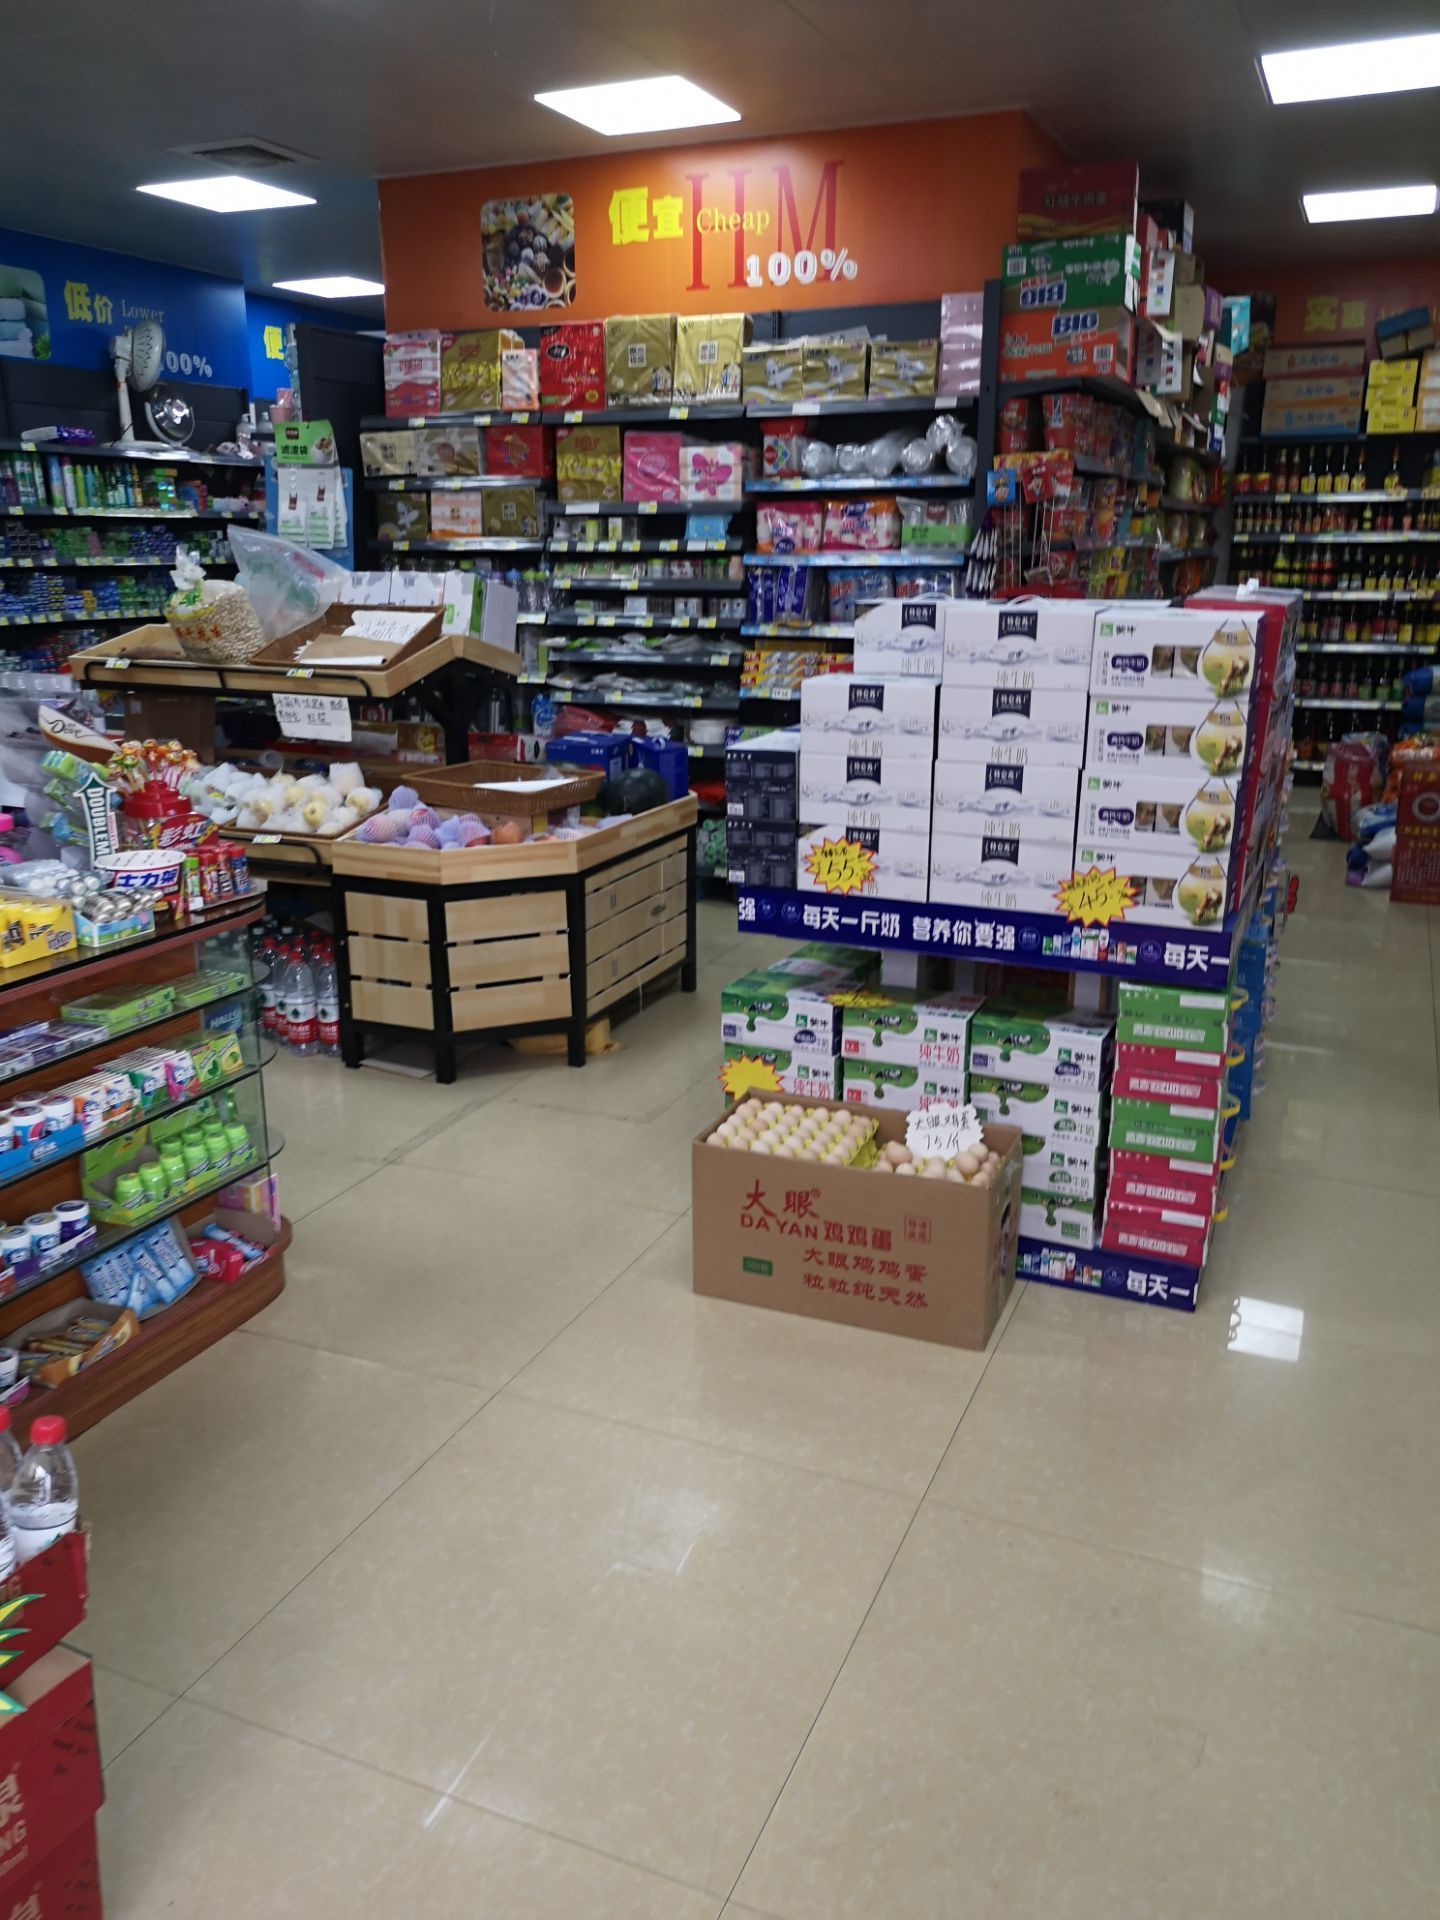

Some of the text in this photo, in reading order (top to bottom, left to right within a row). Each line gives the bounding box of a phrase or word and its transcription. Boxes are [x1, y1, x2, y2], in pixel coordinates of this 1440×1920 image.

[608, 186, 770, 245] 便宜 Cheap
[745, 248, 858, 288] 100%
[64, 280, 165, 325] 低价 Lower
[160, 350, 213, 378] 00%
[159, 820, 206, 848] 彩虹
[118, 868, 180, 890] 士力架
[738, 898, 756, 921] 强
[803, 903, 1015, 951] 每天一斤奶 营养你要强
[1163, 941, 1230, 972] 每天一
[919, 1044, 960, 1067] 纯牛奶
[793, 1078, 831, 1099] 纯牛奶
[742, 1179, 820, 1219] 大眼
[803, 1272, 928, 1309] 粒粒纯天然
[1127, 1270, 1198, 1306] 每天一
